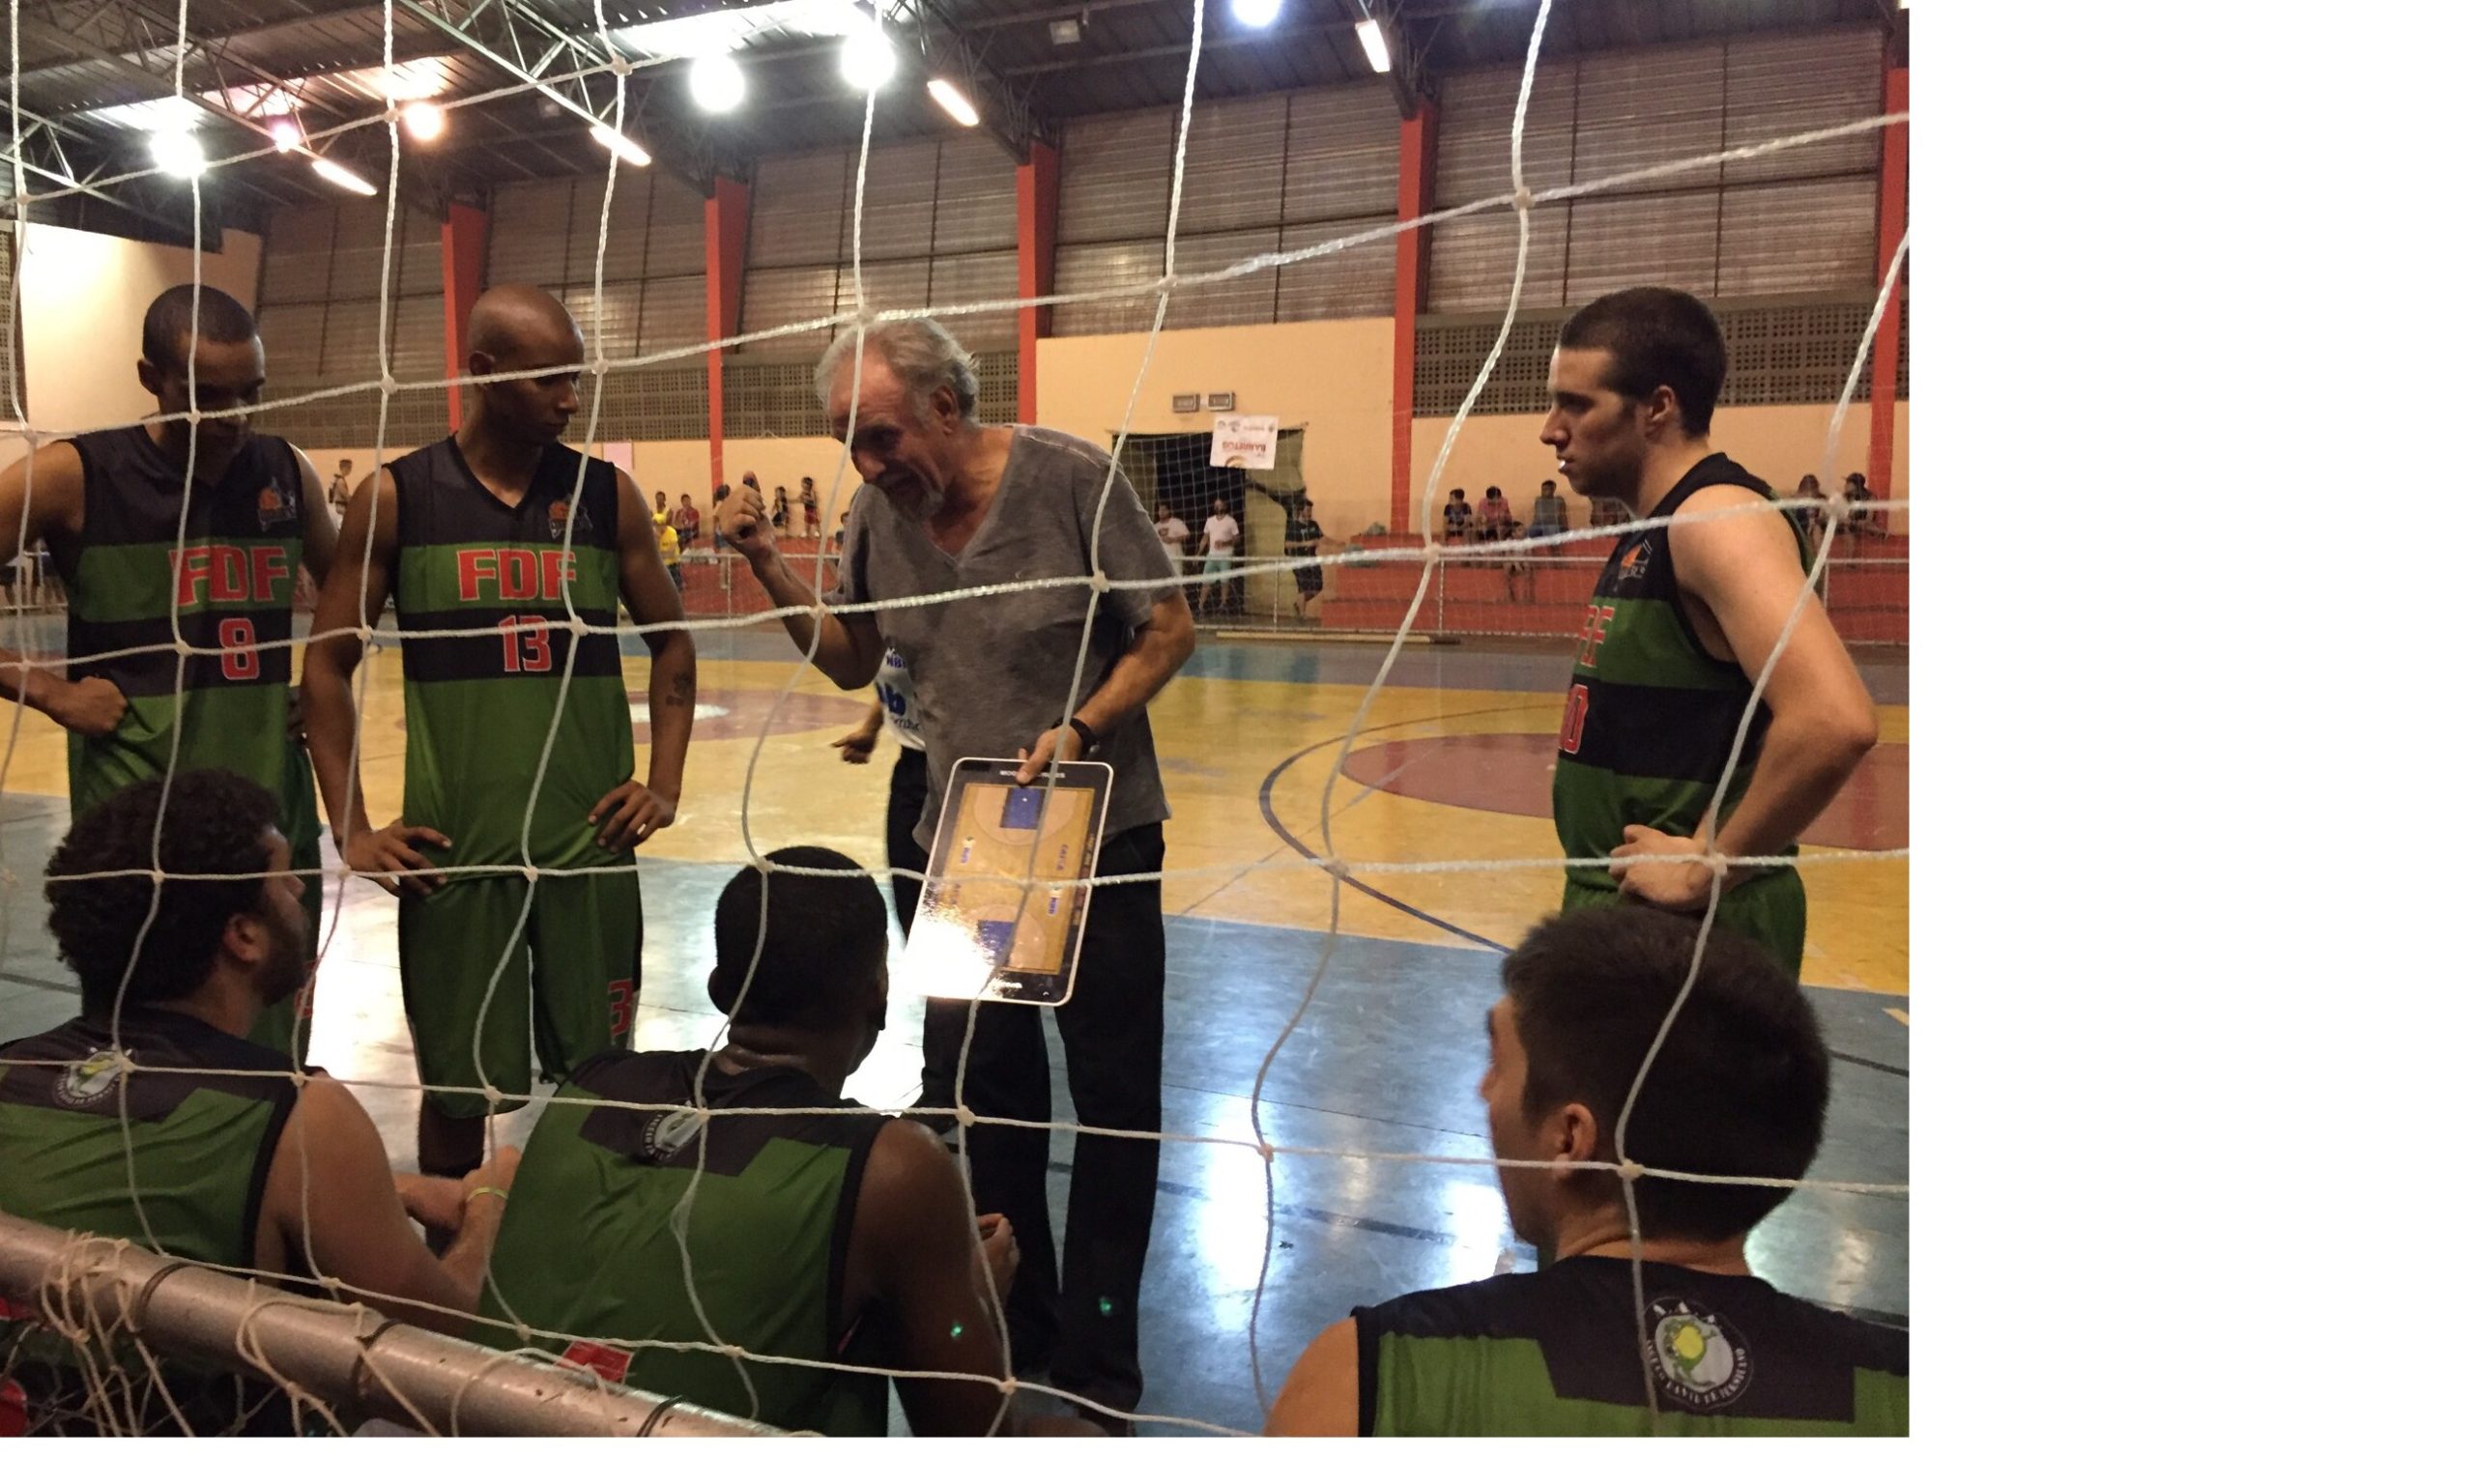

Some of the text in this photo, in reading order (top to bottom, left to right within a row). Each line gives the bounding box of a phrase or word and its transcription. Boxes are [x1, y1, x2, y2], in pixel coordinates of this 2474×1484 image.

[168, 545, 290, 607] FDF
[456, 548, 577, 601] FDF
[218, 617, 260, 681] 8
[498, 614, 553, 672] 13
